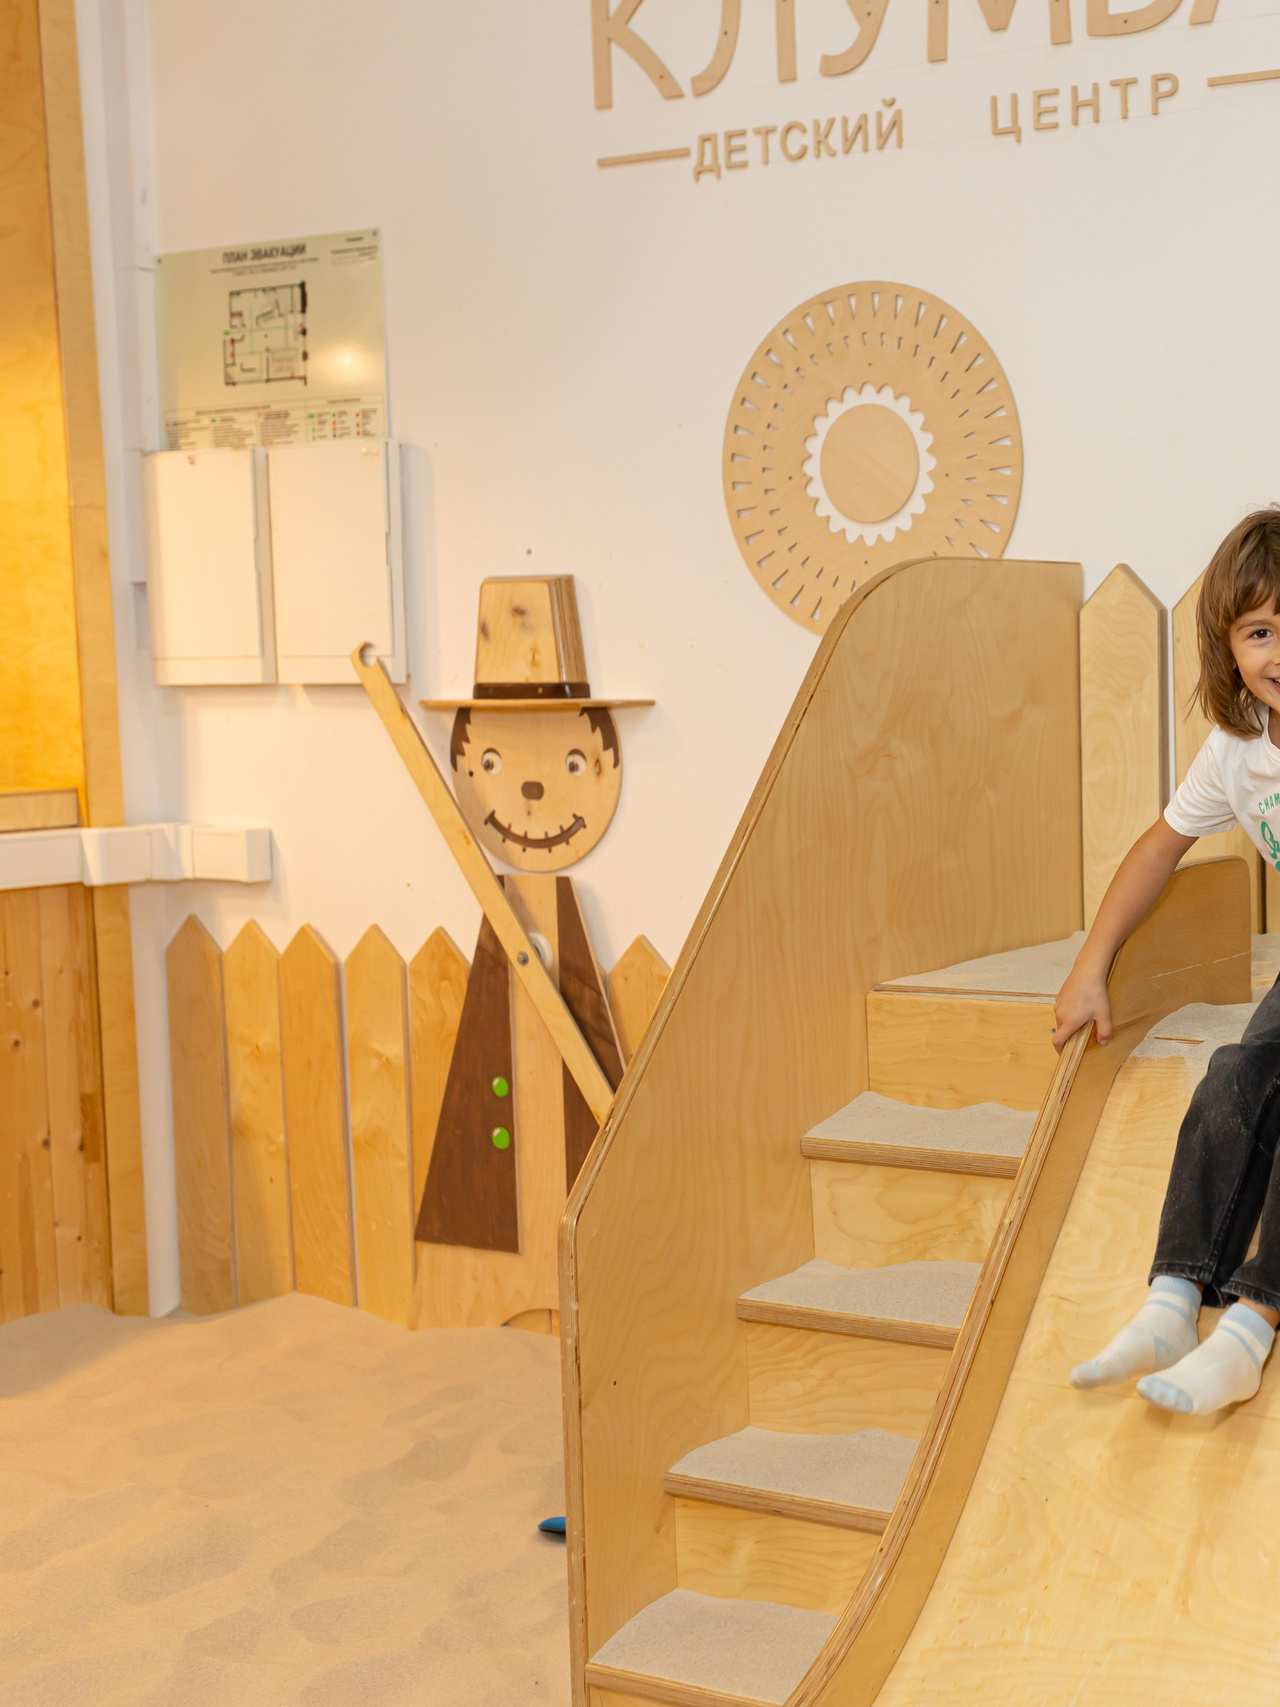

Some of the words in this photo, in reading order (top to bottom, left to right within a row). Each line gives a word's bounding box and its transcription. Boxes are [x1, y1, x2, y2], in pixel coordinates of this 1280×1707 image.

[694, 97, 903, 182] ДЕТСКИЙ
[990, 72, 1180, 144] ЦЕНТР
[222, 251, 249, 264] ПЛАН
